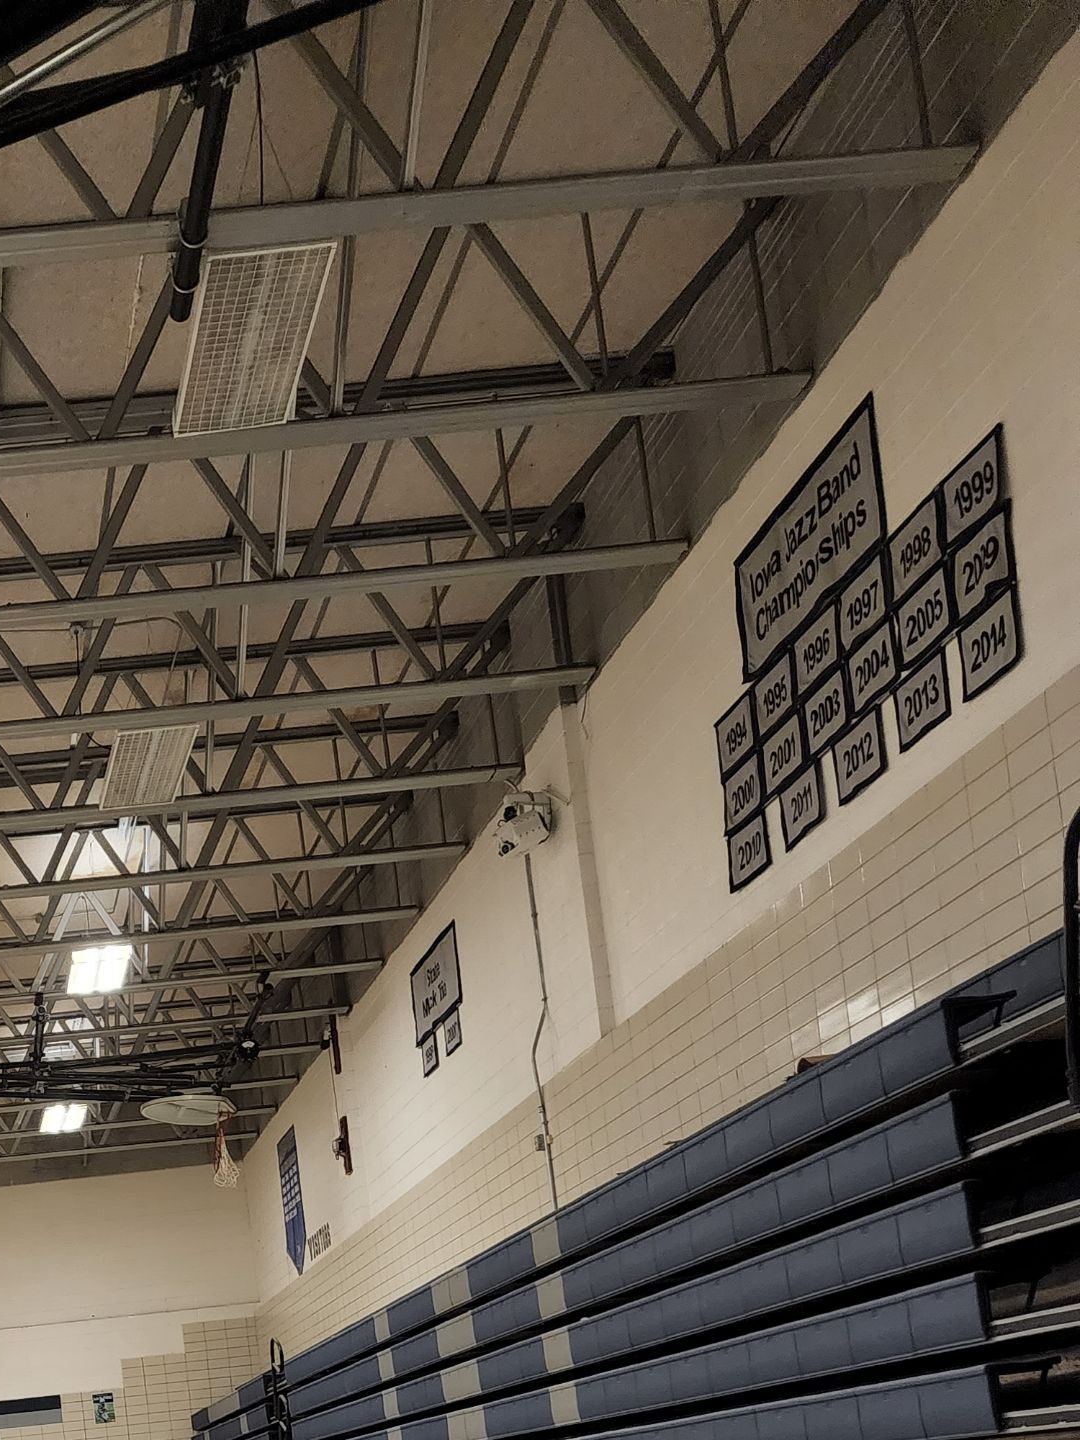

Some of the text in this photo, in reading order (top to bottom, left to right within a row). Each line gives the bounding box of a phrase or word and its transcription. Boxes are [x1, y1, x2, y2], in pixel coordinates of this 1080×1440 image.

[784, 505, 818, 563] Jazz
[817, 440, 861, 519] Band
[953, 460, 994, 519] 1999
[899, 526, 931, 579] 1998
[847, 579, 878, 631] 1997
[905, 587, 943, 648] 2005
[803, 628, 830, 675] 1996
[855, 639, 890, 696] 2004
[971, 614, 1007, 674] 2014
[763, 674, 788, 718] 1995
[810, 688, 841, 738] 2003
[904, 673, 940, 727] 2013
[725, 714, 748, 756] 1994
[770, 731, 796, 779] 2001
[843, 731, 874, 780] 2012
[731, 774, 755, 817] 2000
[790, 782, 813, 824] 2011
[737, 831, 761, 871] 2010
